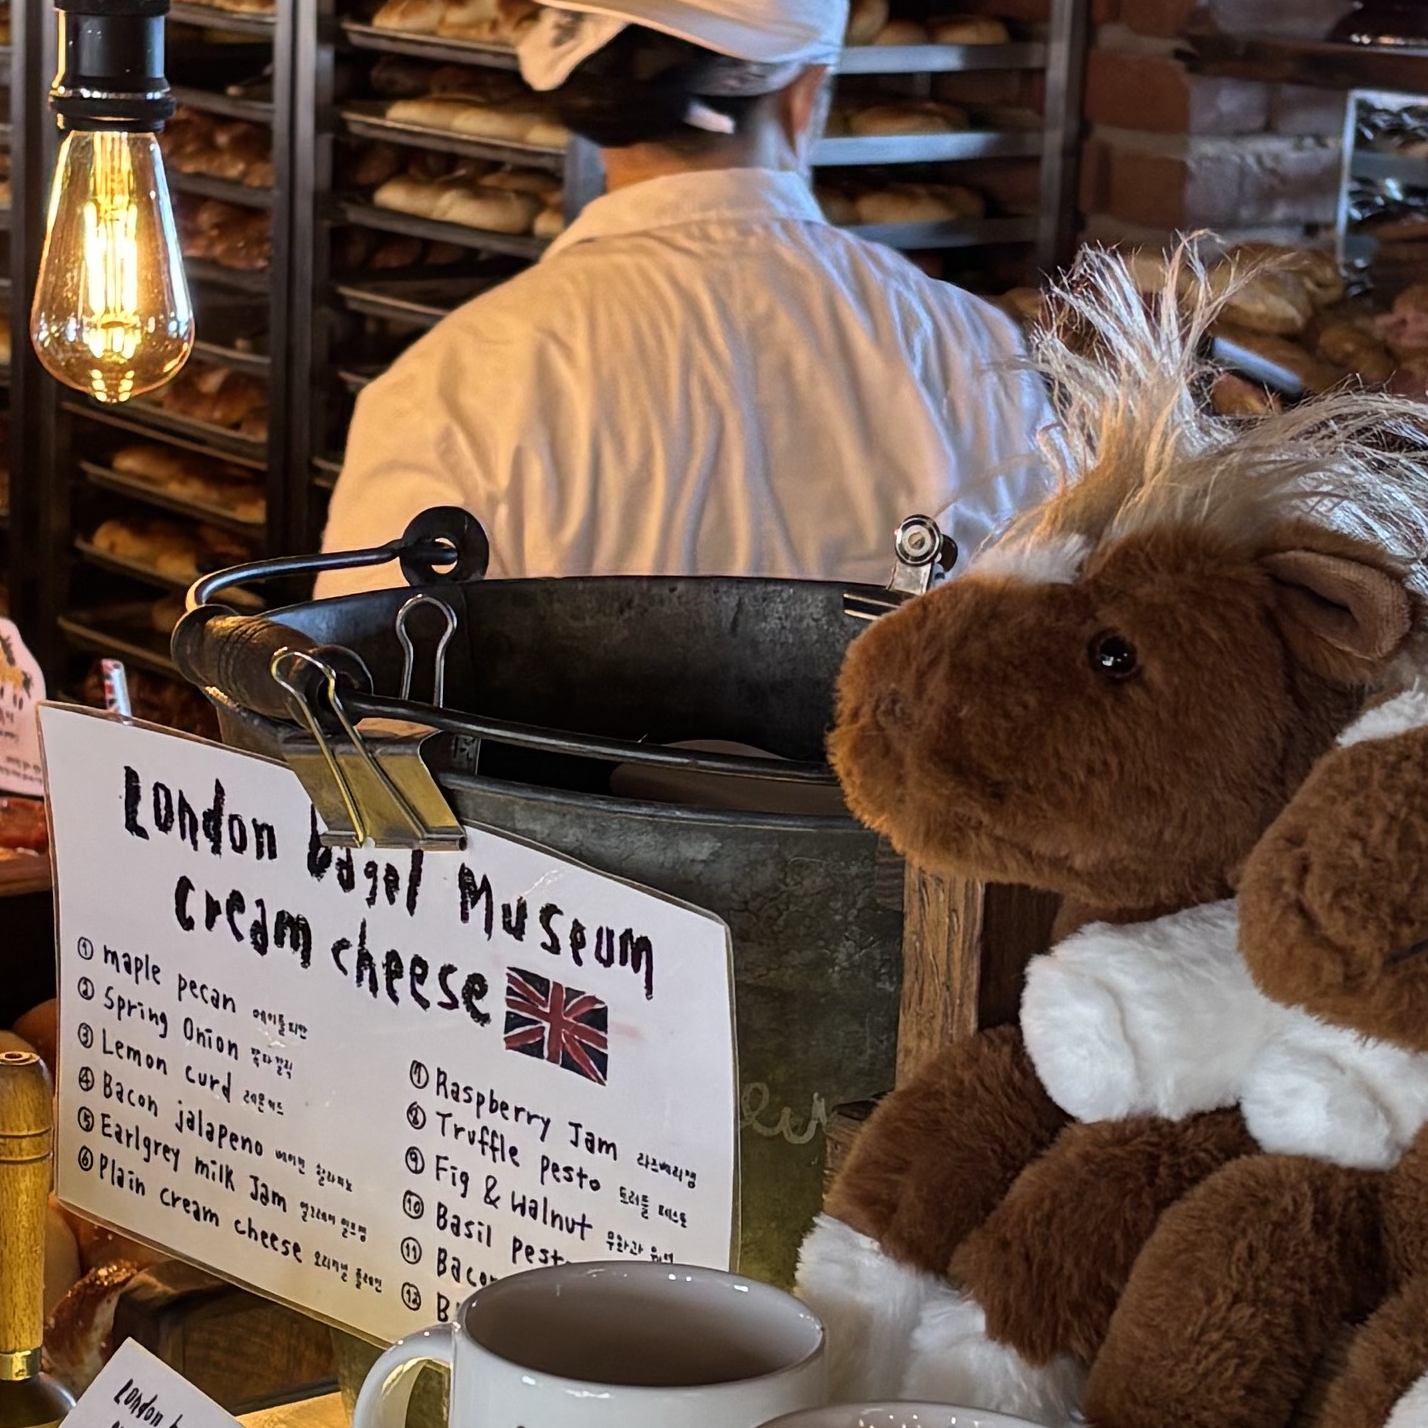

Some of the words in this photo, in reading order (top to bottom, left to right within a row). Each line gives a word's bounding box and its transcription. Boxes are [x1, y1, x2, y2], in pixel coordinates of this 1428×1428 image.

[123, 765, 278, 861] London
[458, 862, 655, 1000] Museum
[104, 944, 161, 985] maple
[330, 918, 492, 1028] cheese
[104, 986, 168, 1039] Spring
[183, 1017, 239, 1061] Onion
[102, 1028, 168, 1076] Lemon
[103, 1070, 159, 1118] Bacon
[175, 1101, 264, 1158] jalapeno
[435, 1067, 552, 1143] Raspberry
[568, 1121, 618, 1161] Jam
[435, 1111, 521, 1168] Truffle
[100, 1113, 181, 1172] Earlgrey
[249, 1173, 288, 1213] Jam
[435, 1154, 470, 1198] Fig
[484, 1174, 499, 1210] &
[233, 1218, 304, 1264] cheese
[435, 1201, 493, 1248] Basil
[435, 1247, 498, 1288] Baco
[113, 1378, 164, 1428] London
